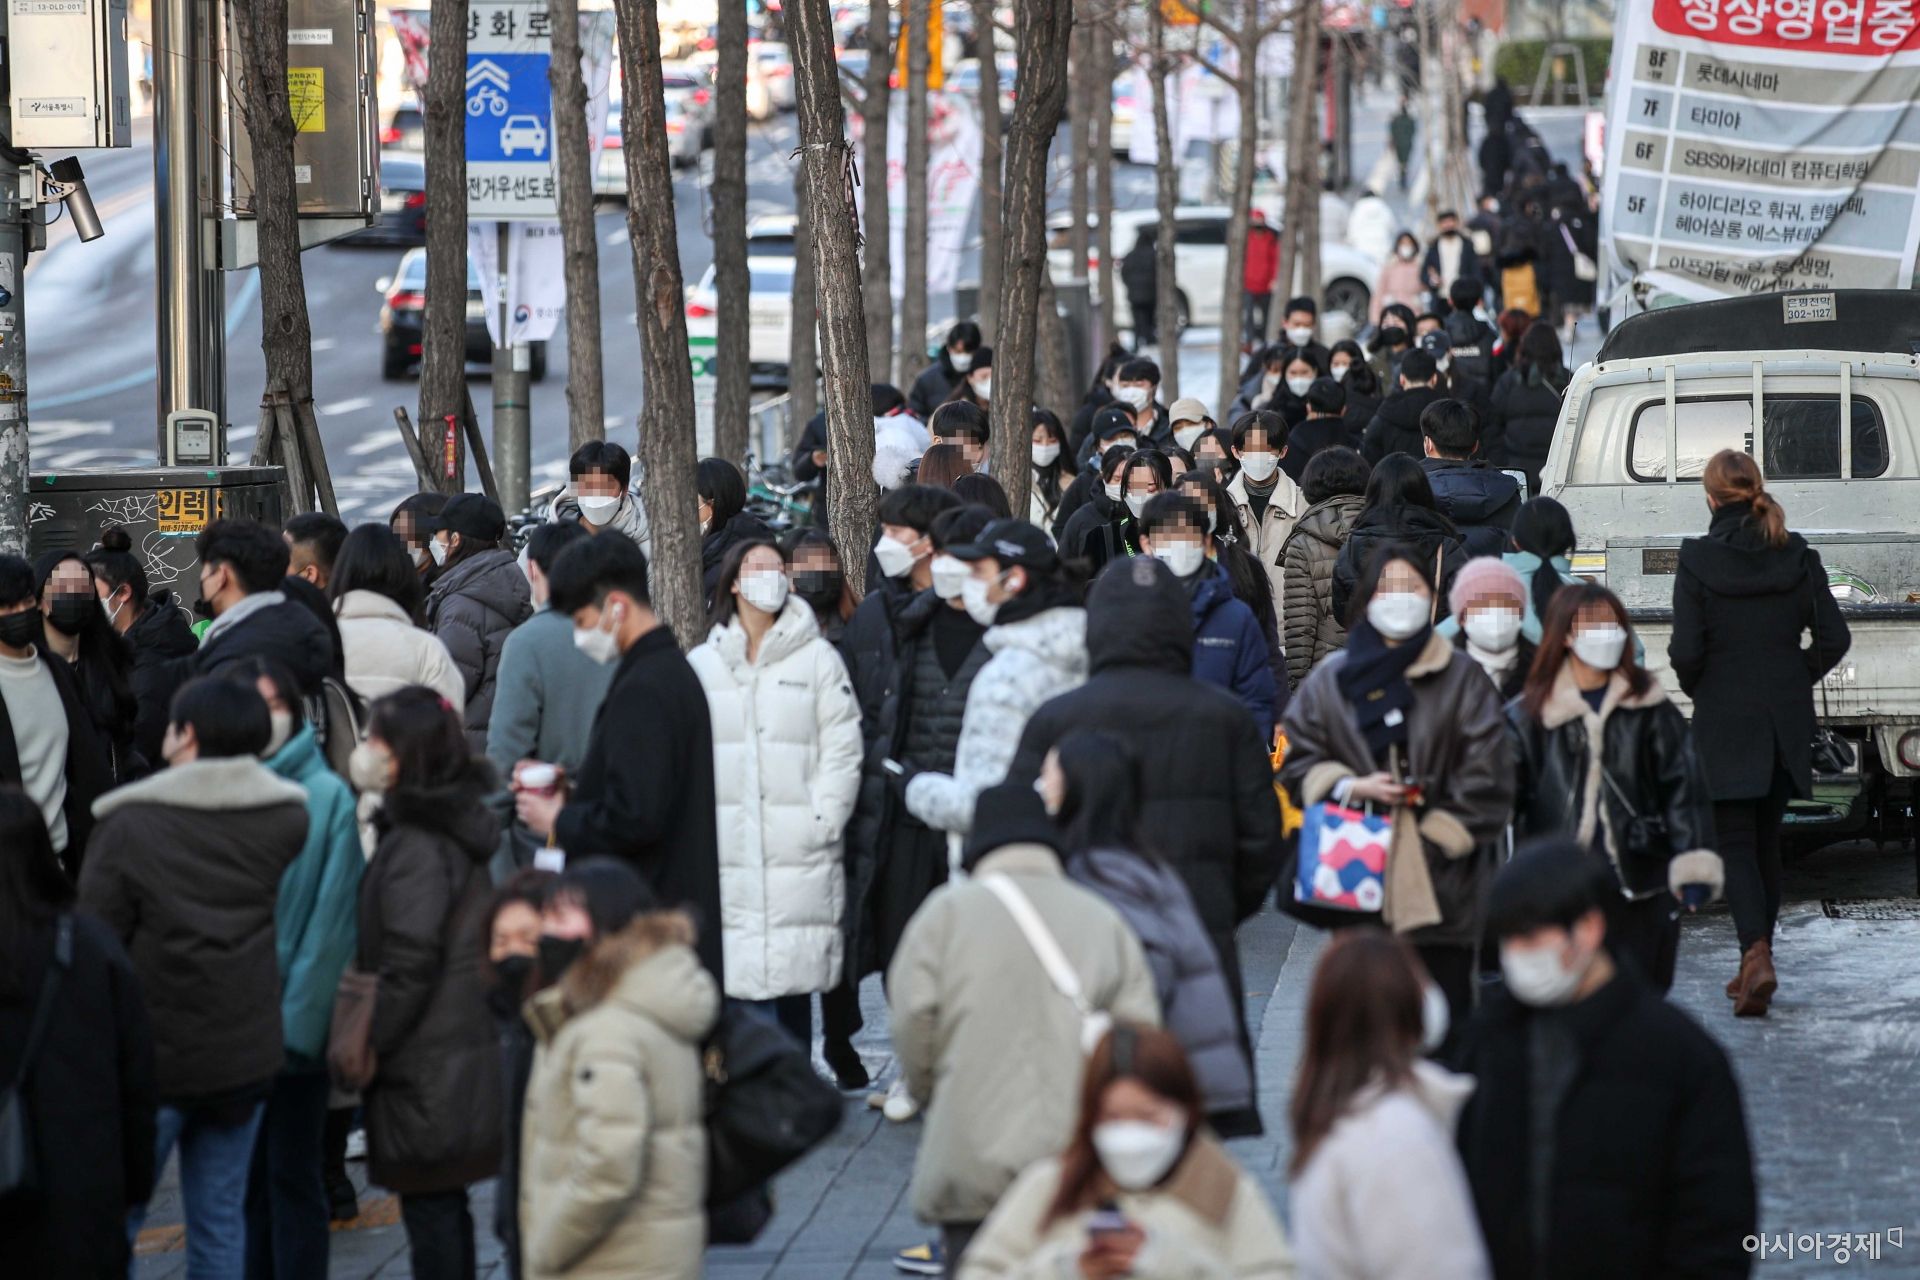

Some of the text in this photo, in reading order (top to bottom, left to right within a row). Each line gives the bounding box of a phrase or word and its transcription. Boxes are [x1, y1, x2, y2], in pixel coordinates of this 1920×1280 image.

[1648, 49, 1668, 67] 8F
[1696, 64, 1780, 93] 롯데시네마
[41, 103, 73, 112] 서울특별시
[1642, 98, 1660, 117] 7F
[1691, 106, 1741, 131] 타미야
[1635, 142, 1655, 160] 6F
[1684, 149, 1870, 182] SBS아카데미 컴퓨터학원
[1627, 195, 1647, 214] 5F
[1679, 191, 1763, 218] 하이디라오
[1809, 196, 1867, 223] 헌혈페,
[1675, 215, 1743, 242] 헤어살롱
[1787, 296, 1831, 308] 은평천막
[158, 490, 206, 521] 인력
